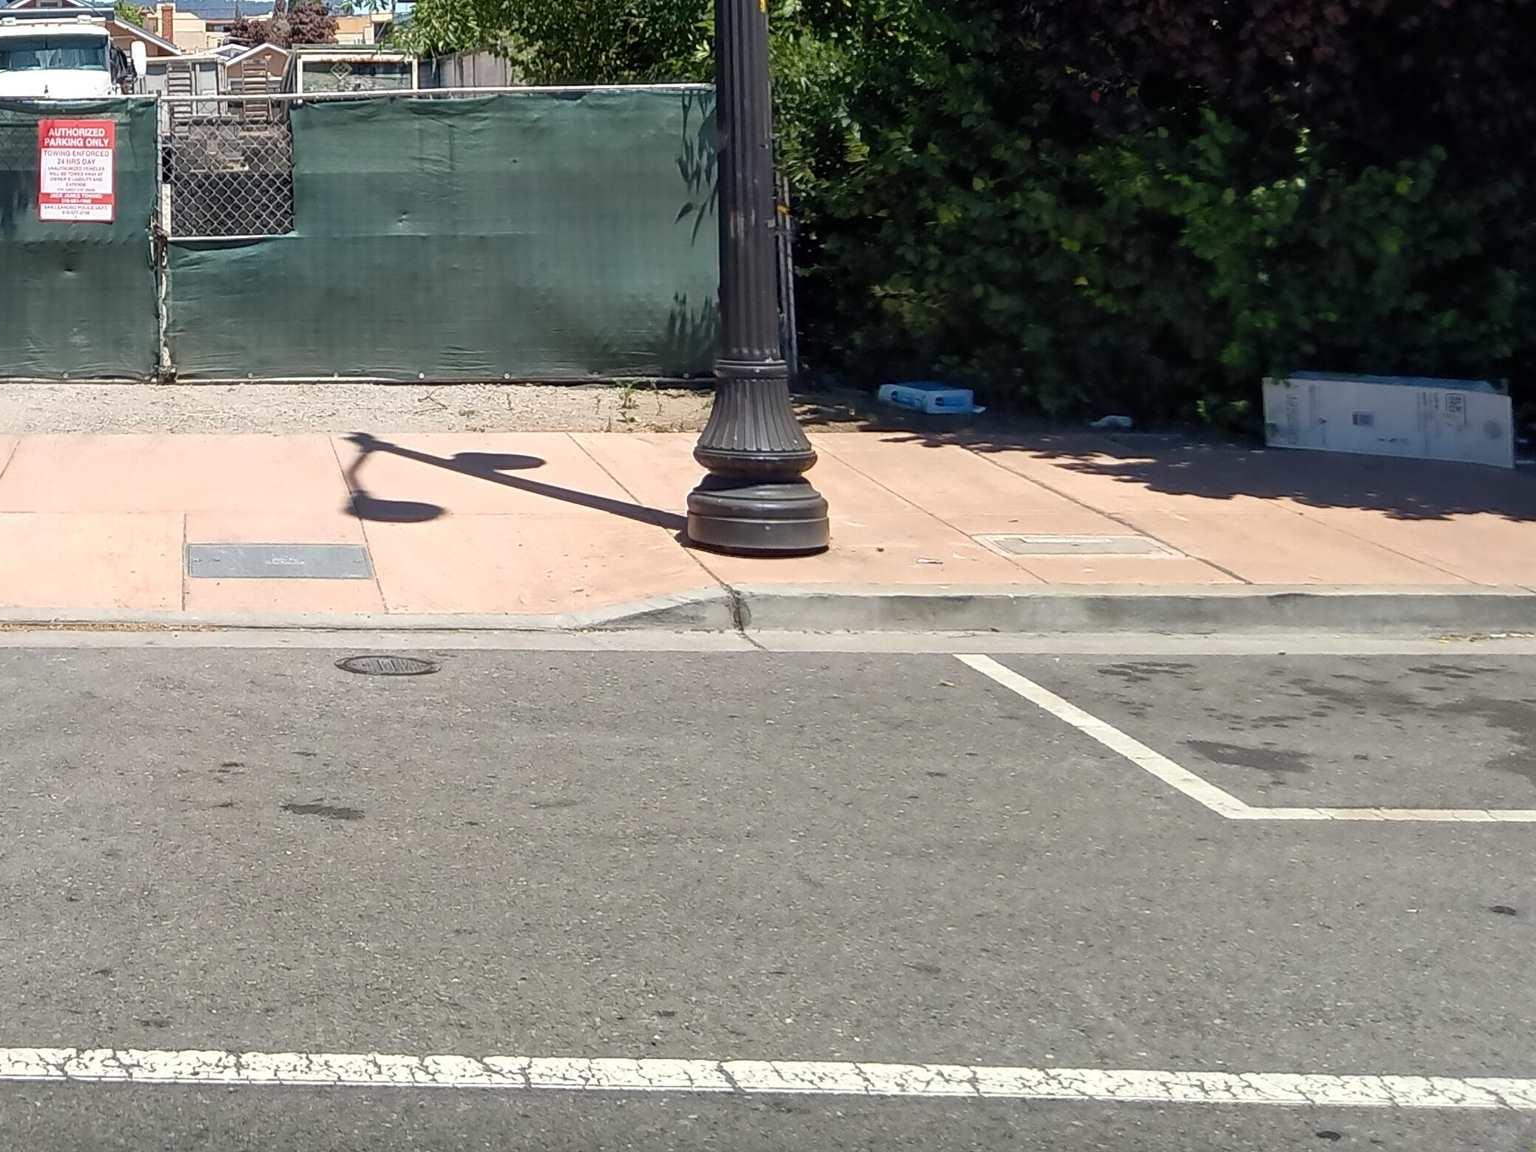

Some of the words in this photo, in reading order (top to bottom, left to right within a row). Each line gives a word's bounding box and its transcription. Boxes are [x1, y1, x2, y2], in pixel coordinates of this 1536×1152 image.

[48, 128, 106, 137] AUTHORIZED
[44, 137, 83, 147] PARKING
[85, 137, 109, 147] ONLY
